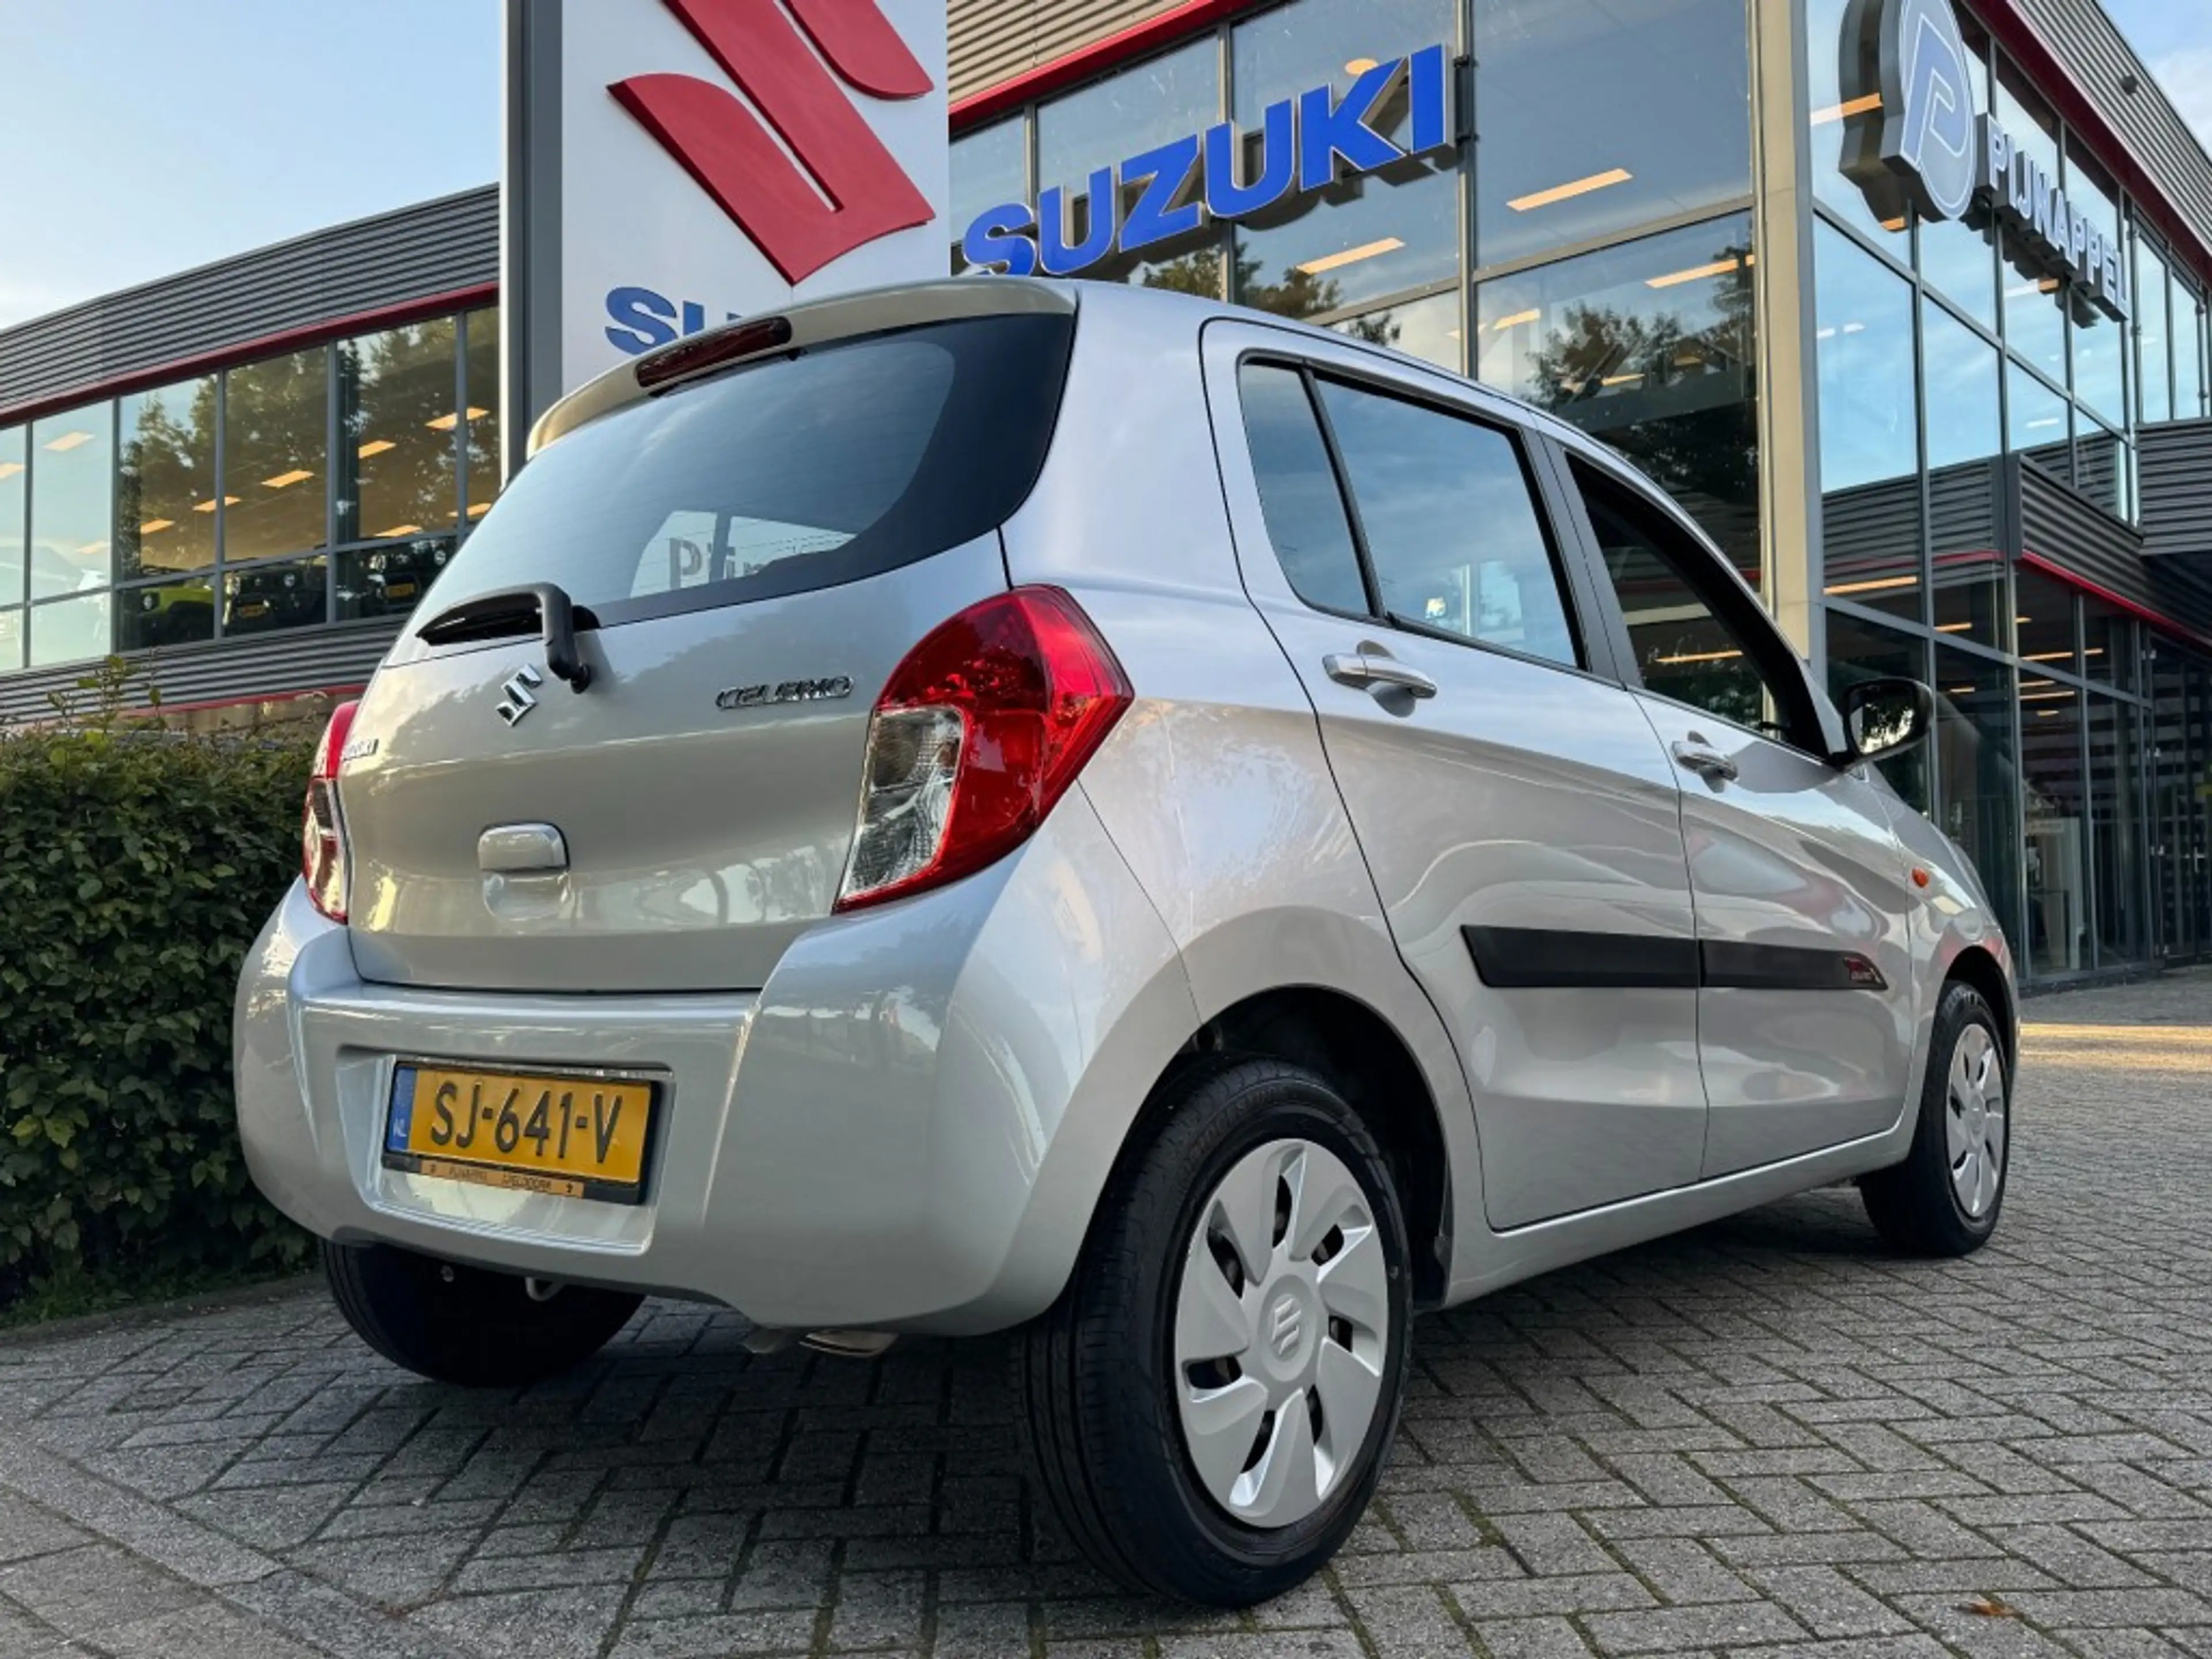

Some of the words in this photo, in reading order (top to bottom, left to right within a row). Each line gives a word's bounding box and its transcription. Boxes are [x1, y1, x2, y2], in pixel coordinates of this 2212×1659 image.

[962, 44, 1452, 276] SUZUKI
[1986, 113, 2128, 321] PIJNAPPEL
[430, 1081, 623, 1164] SJ-641-V
